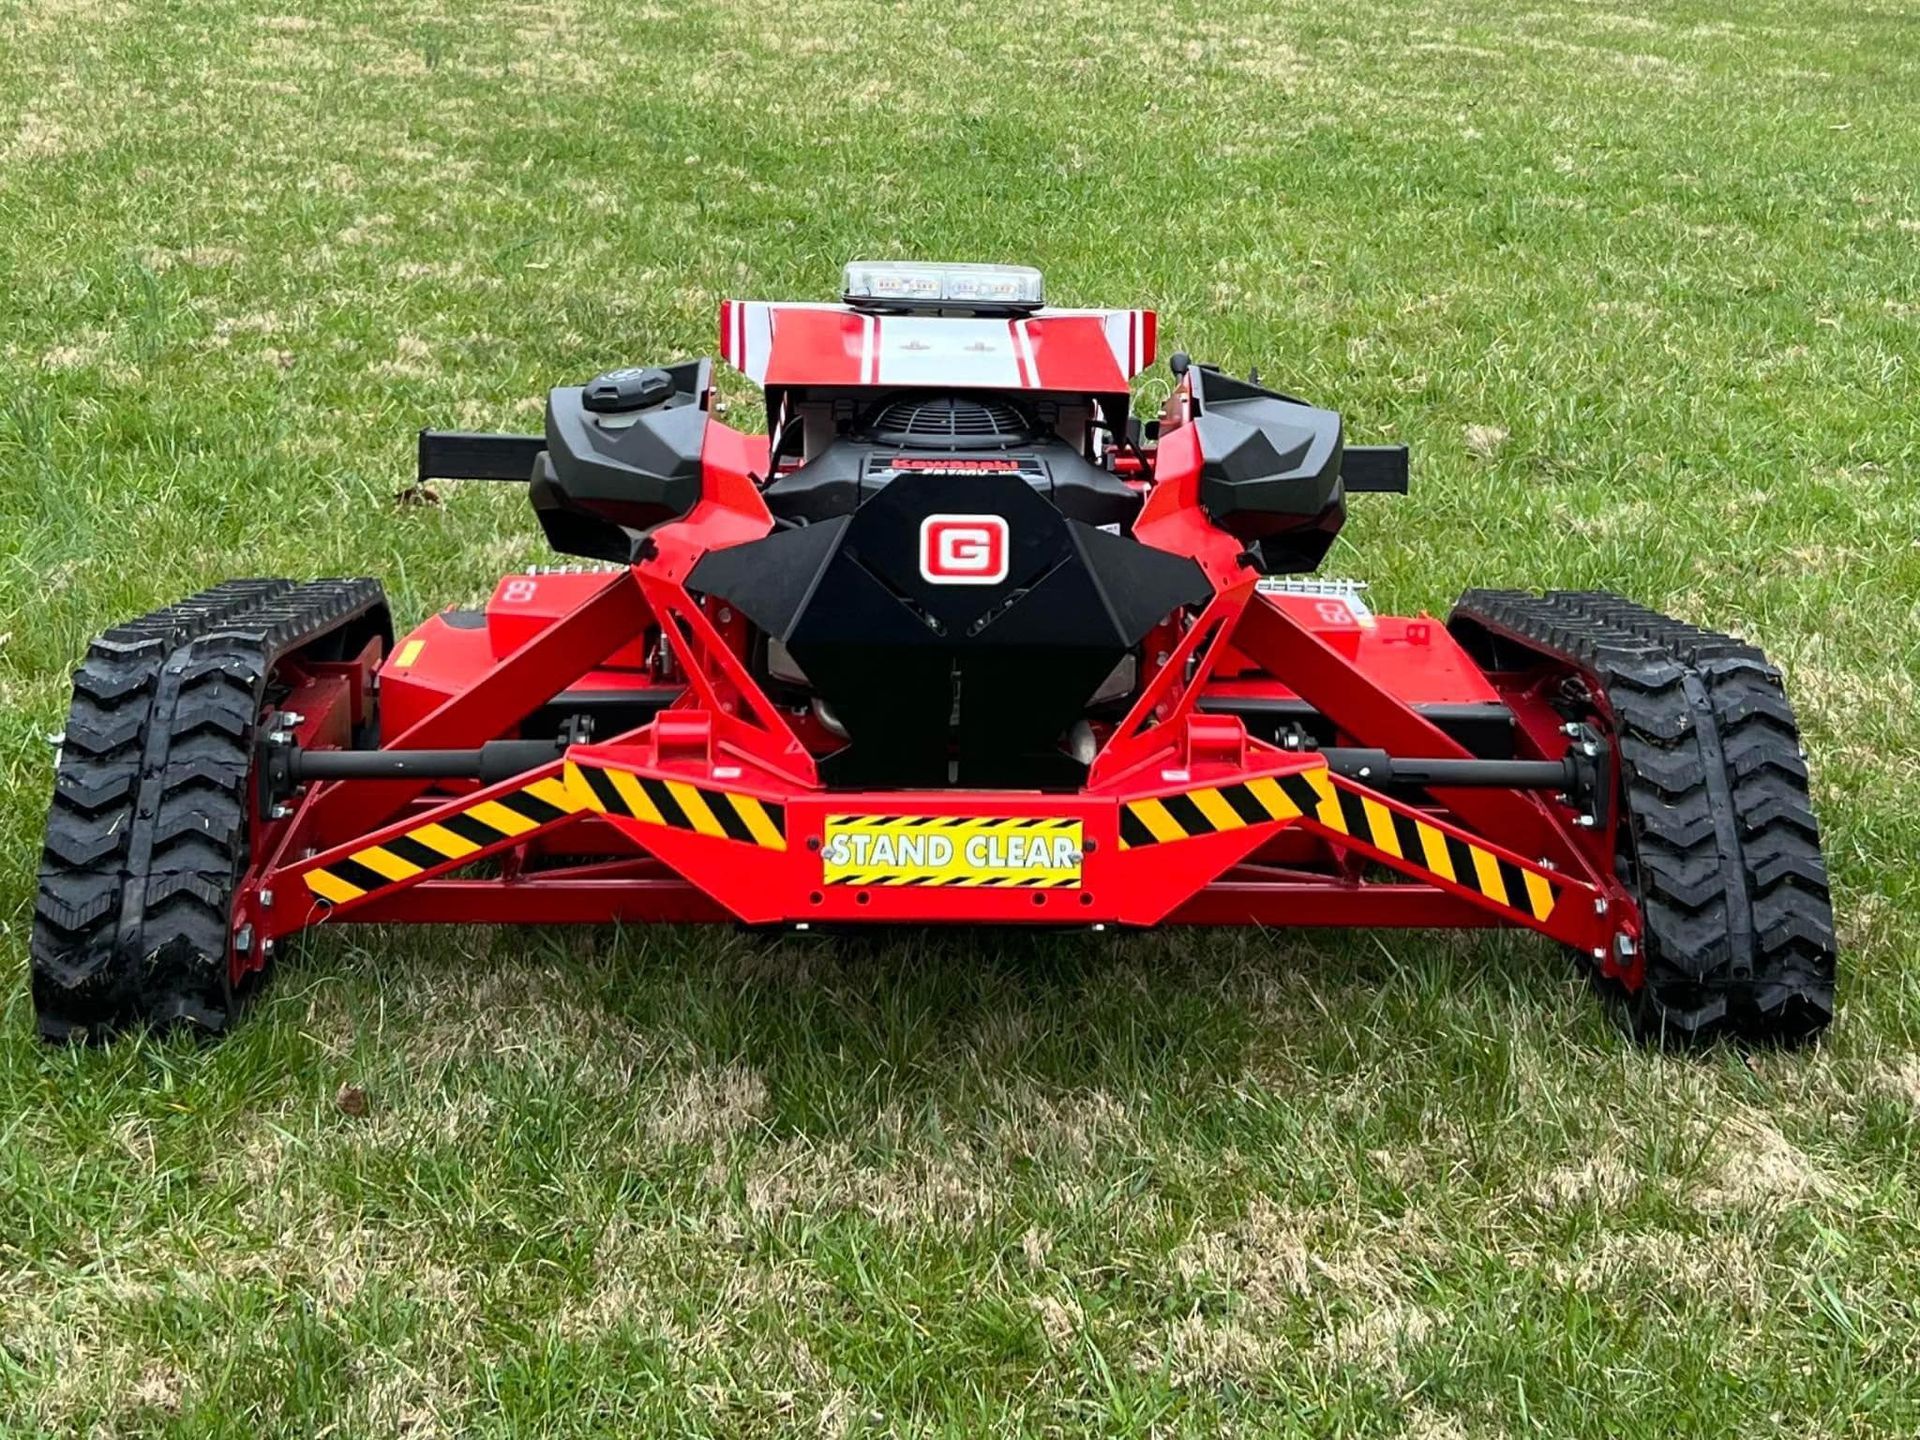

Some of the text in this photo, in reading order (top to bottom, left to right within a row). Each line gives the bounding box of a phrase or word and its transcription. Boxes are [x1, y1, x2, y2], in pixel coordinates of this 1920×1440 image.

[891, 459, 1019, 469] Kawasaki
[939, 528, 990, 570] G
[830, 833, 1076, 868] STAND CLEAR
